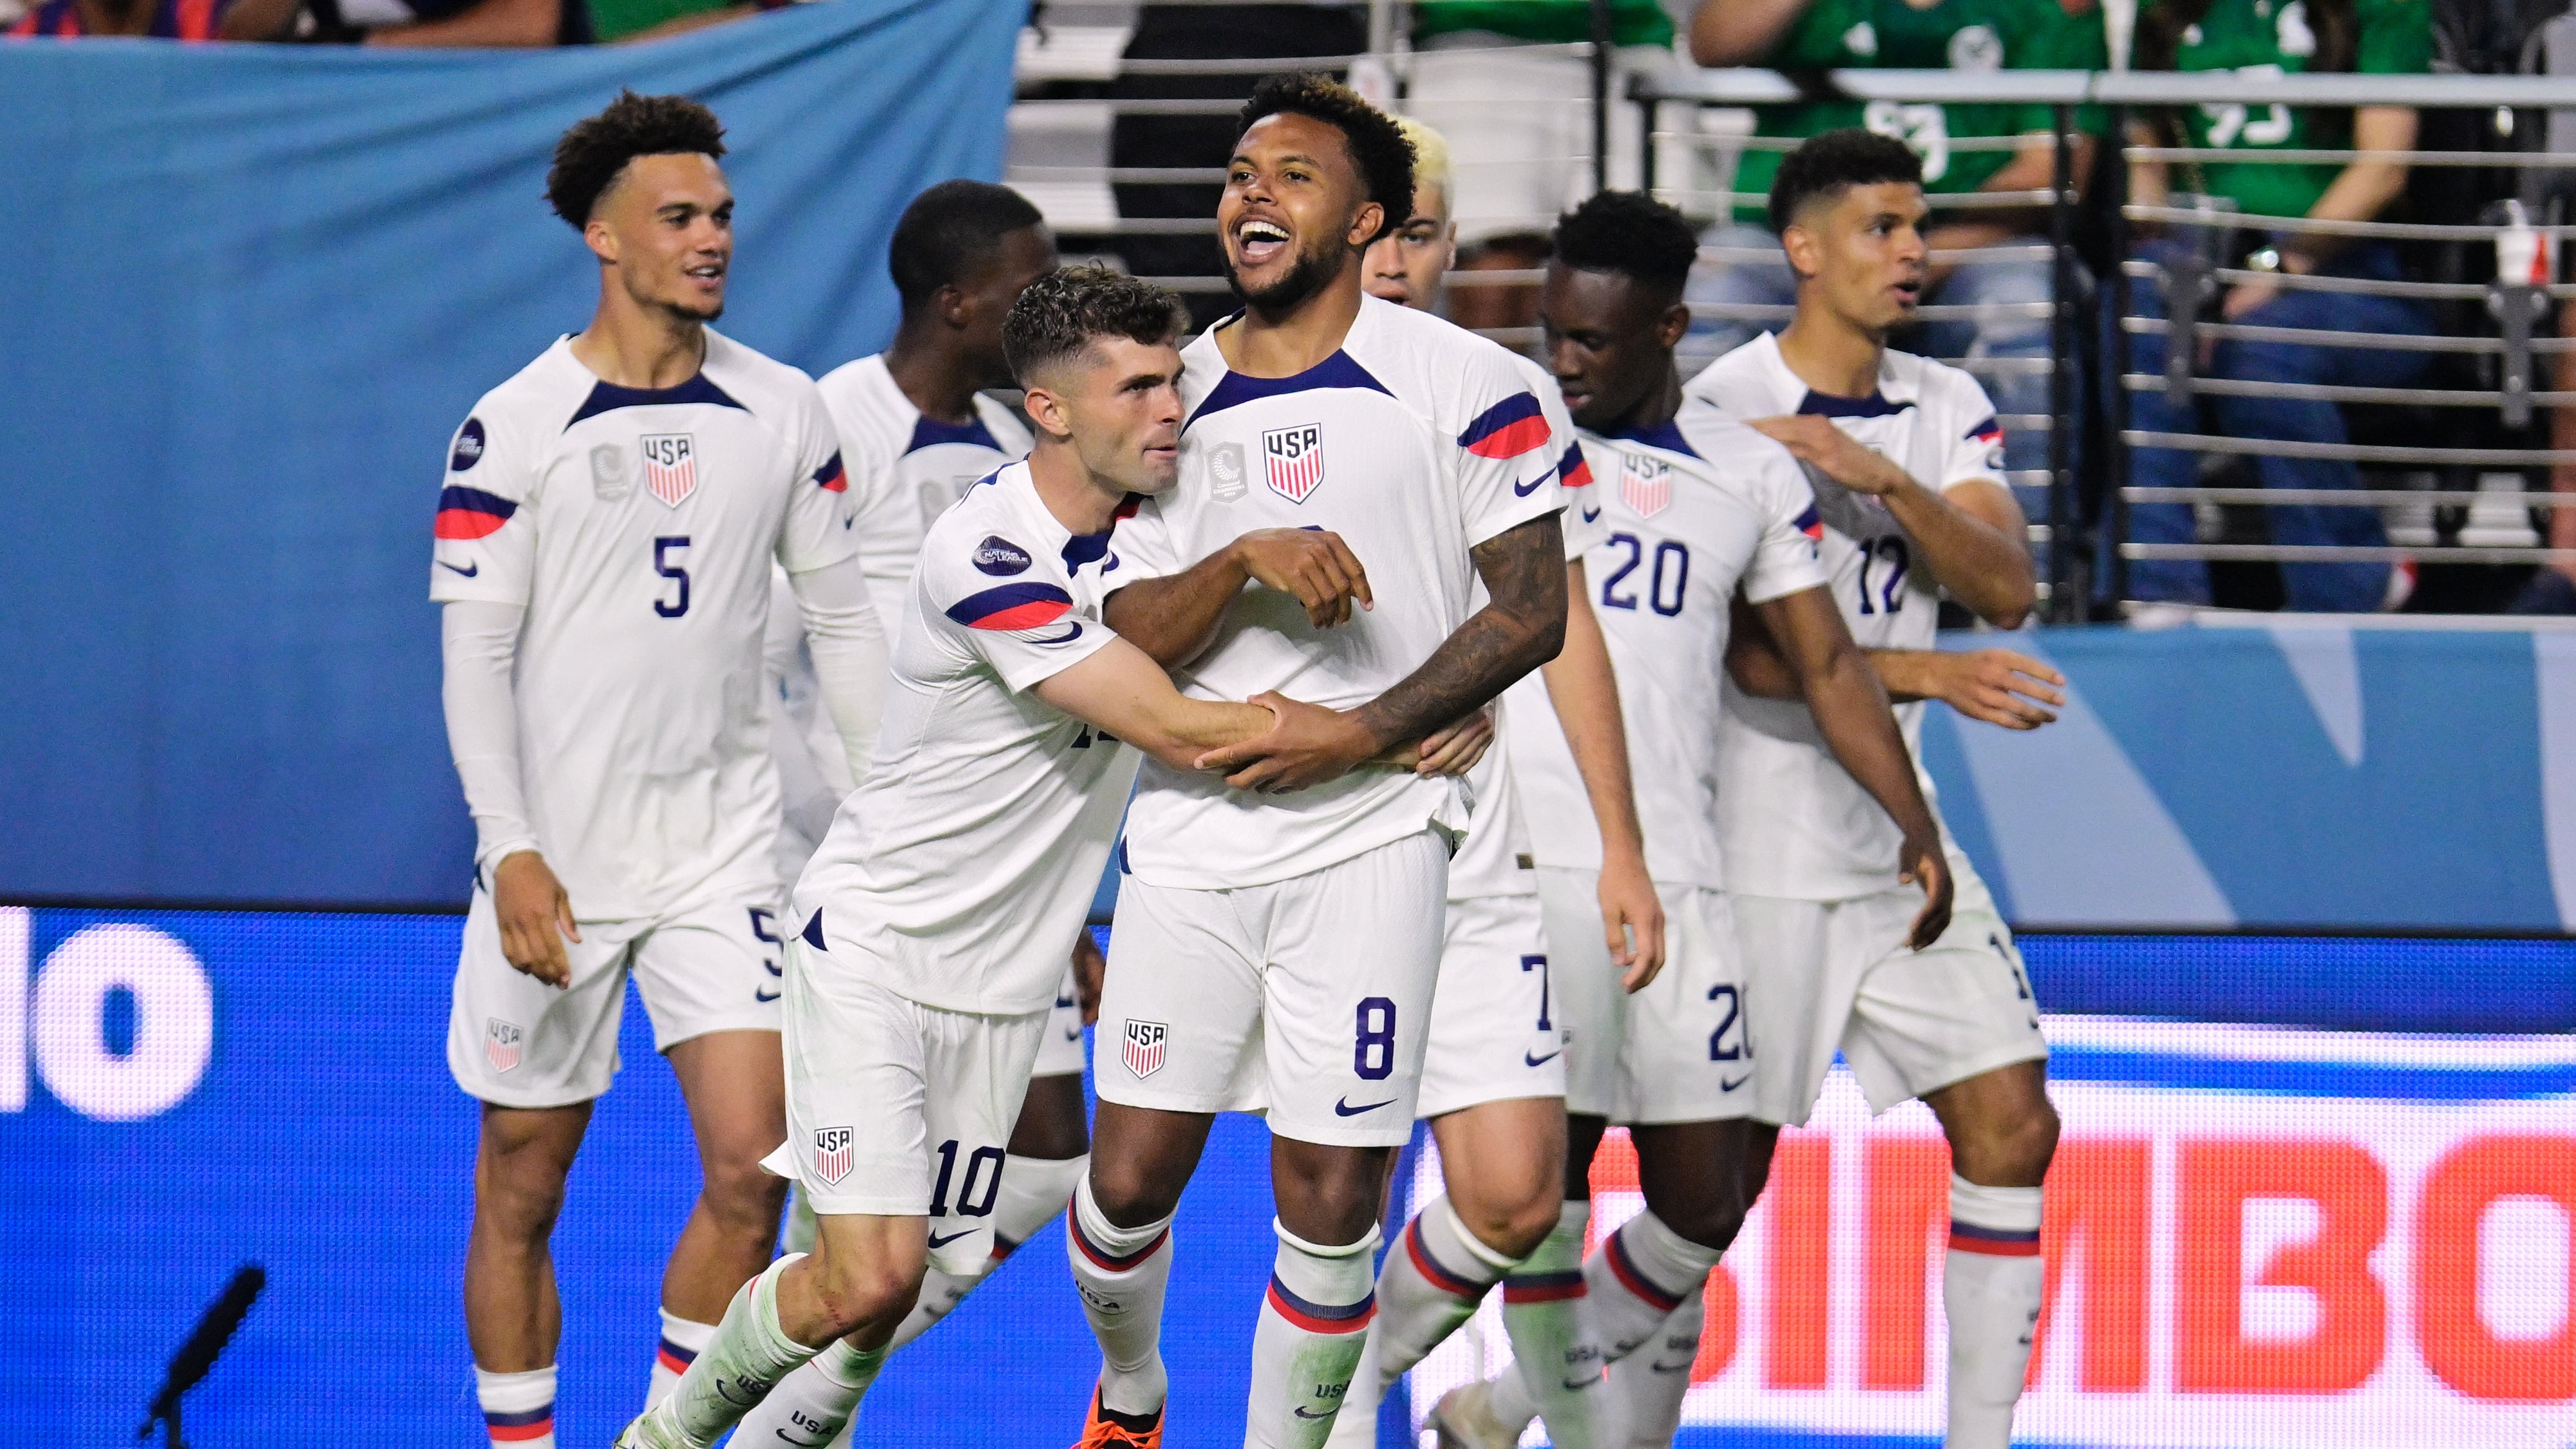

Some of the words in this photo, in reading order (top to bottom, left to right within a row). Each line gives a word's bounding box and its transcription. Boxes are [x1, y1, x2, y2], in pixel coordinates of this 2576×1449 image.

[645, 438, 689, 465] USA
[1268, 428, 1317, 459] USA
[1625, 453, 1669, 478] USA
[654, 536, 690, 618] 5
[1602, 533, 1689, 616] 20
[1859, 535, 1908, 613] 12
[1520, 954, 1552, 1031] 7
[490, 1021, 520, 1045] USA
[1128, 1023, 1164, 1046] USA
[1354, 996, 1396, 1080] 8
[817, 1130, 849, 1152] USA
[929, 1139, 1006, 1218] 10
[1582, 1132, 2576, 1404] IMBO
[791, 1410, 833, 1435] USA
